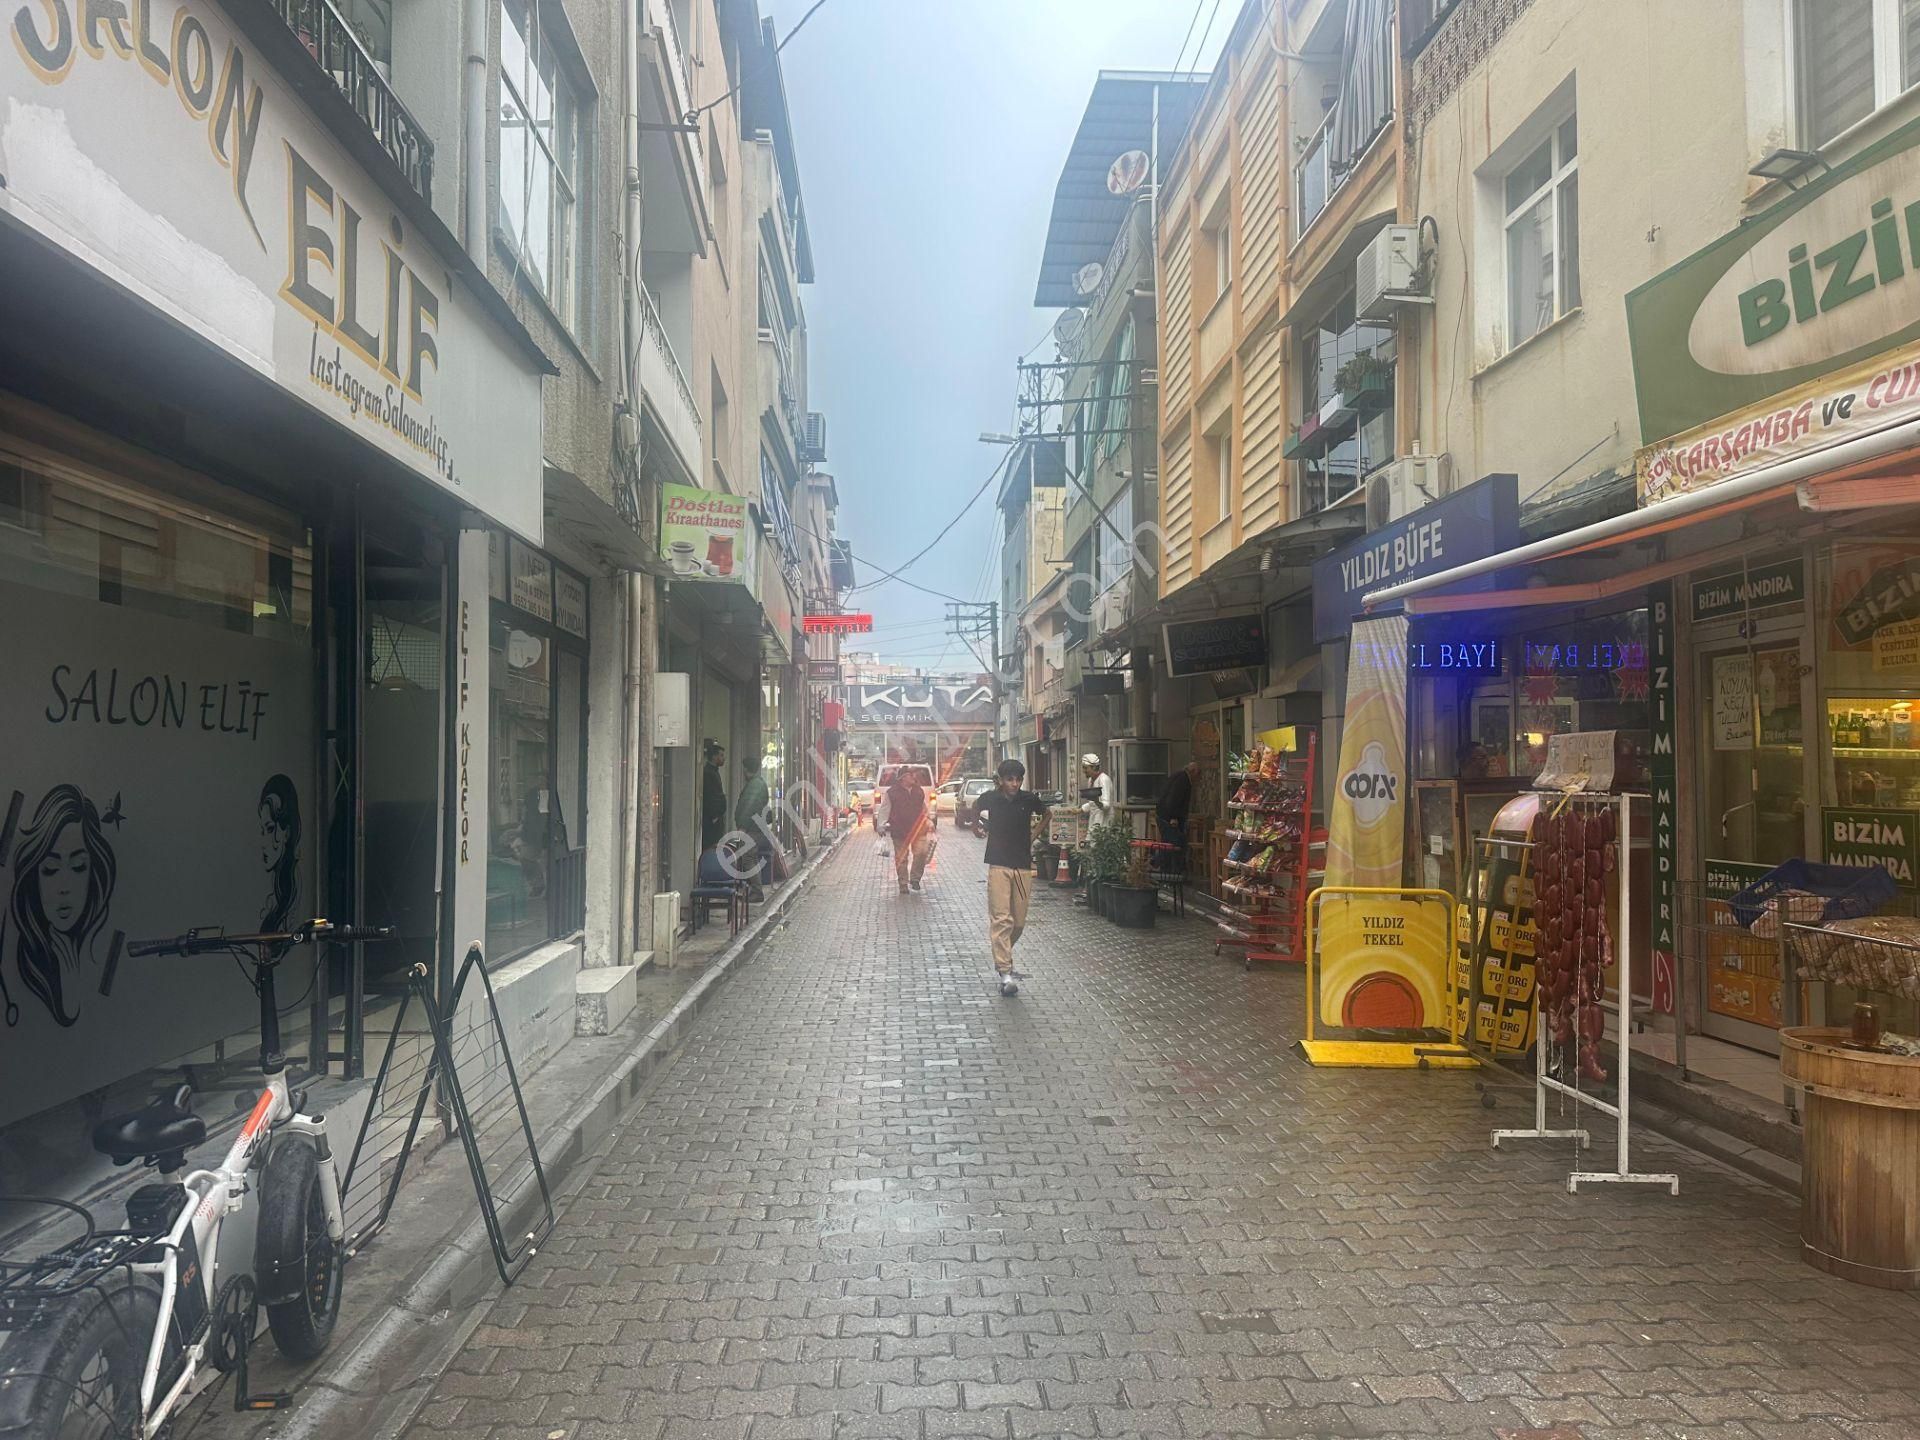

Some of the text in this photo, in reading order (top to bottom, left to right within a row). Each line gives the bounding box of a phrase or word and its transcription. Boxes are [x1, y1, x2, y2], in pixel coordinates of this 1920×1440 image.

[1674, 401, 1814, 488] ÇARŞAMBA
[1822, 393, 1856, 427] ve
[669, 496, 744, 513] Dostlar
[1341, 518, 1443, 593] YILDIZ BÜFE
[1698, 574, 1793, 610] BİZİM MANDIRA
[1440, 640, 1496, 668] BAYİ
[1653, 601, 1673, 755] BİZİM
[45, 665, 187, 729] SALON
[1833, 816, 1906, 847] BİZİM
[1656, 788, 1673, 944] MANDIRA
[1707, 869, 1741, 891] BİZİM
[1362, 916, 1405, 929] YILDIZ
[1362, 934, 1404, 946] TEKEL
[1488, 971, 1528, 987] TUORG
[1480, 1016, 1520, 1033] TUORG
